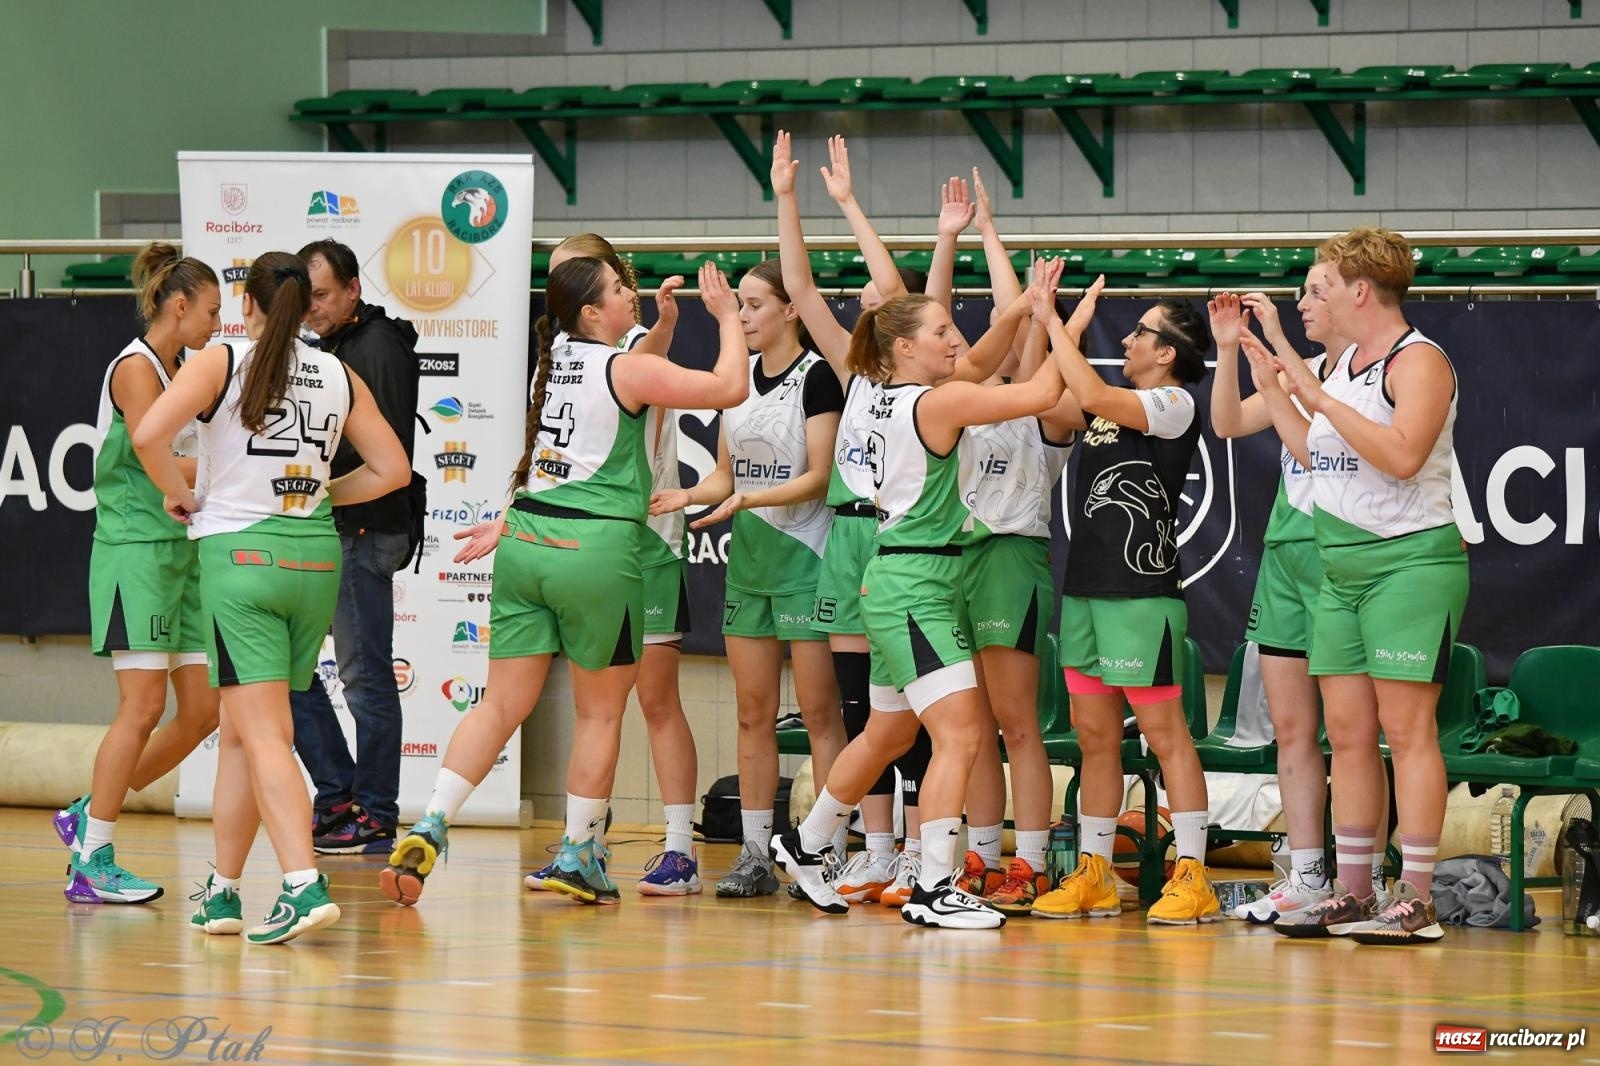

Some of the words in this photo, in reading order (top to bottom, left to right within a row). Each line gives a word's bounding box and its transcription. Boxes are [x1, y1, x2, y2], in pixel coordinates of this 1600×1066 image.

[206, 221, 263, 234] Racibórz
[411, 229, 446, 275] 10
[405, 280, 422, 297] LAT
[425, 281, 454, 298] KLUBU
[418, 358, 456, 371] ZKosz
[247, 397, 338, 462] 24
[437, 454, 474, 467] SEGET
[735, 459, 792, 479] Clavis
[1310, 450, 1359, 472] Clavis
[275, 477, 318, 494] SEGET
[432, 509, 468, 523] FIZJO
[402, 743, 437, 754] AMAN
